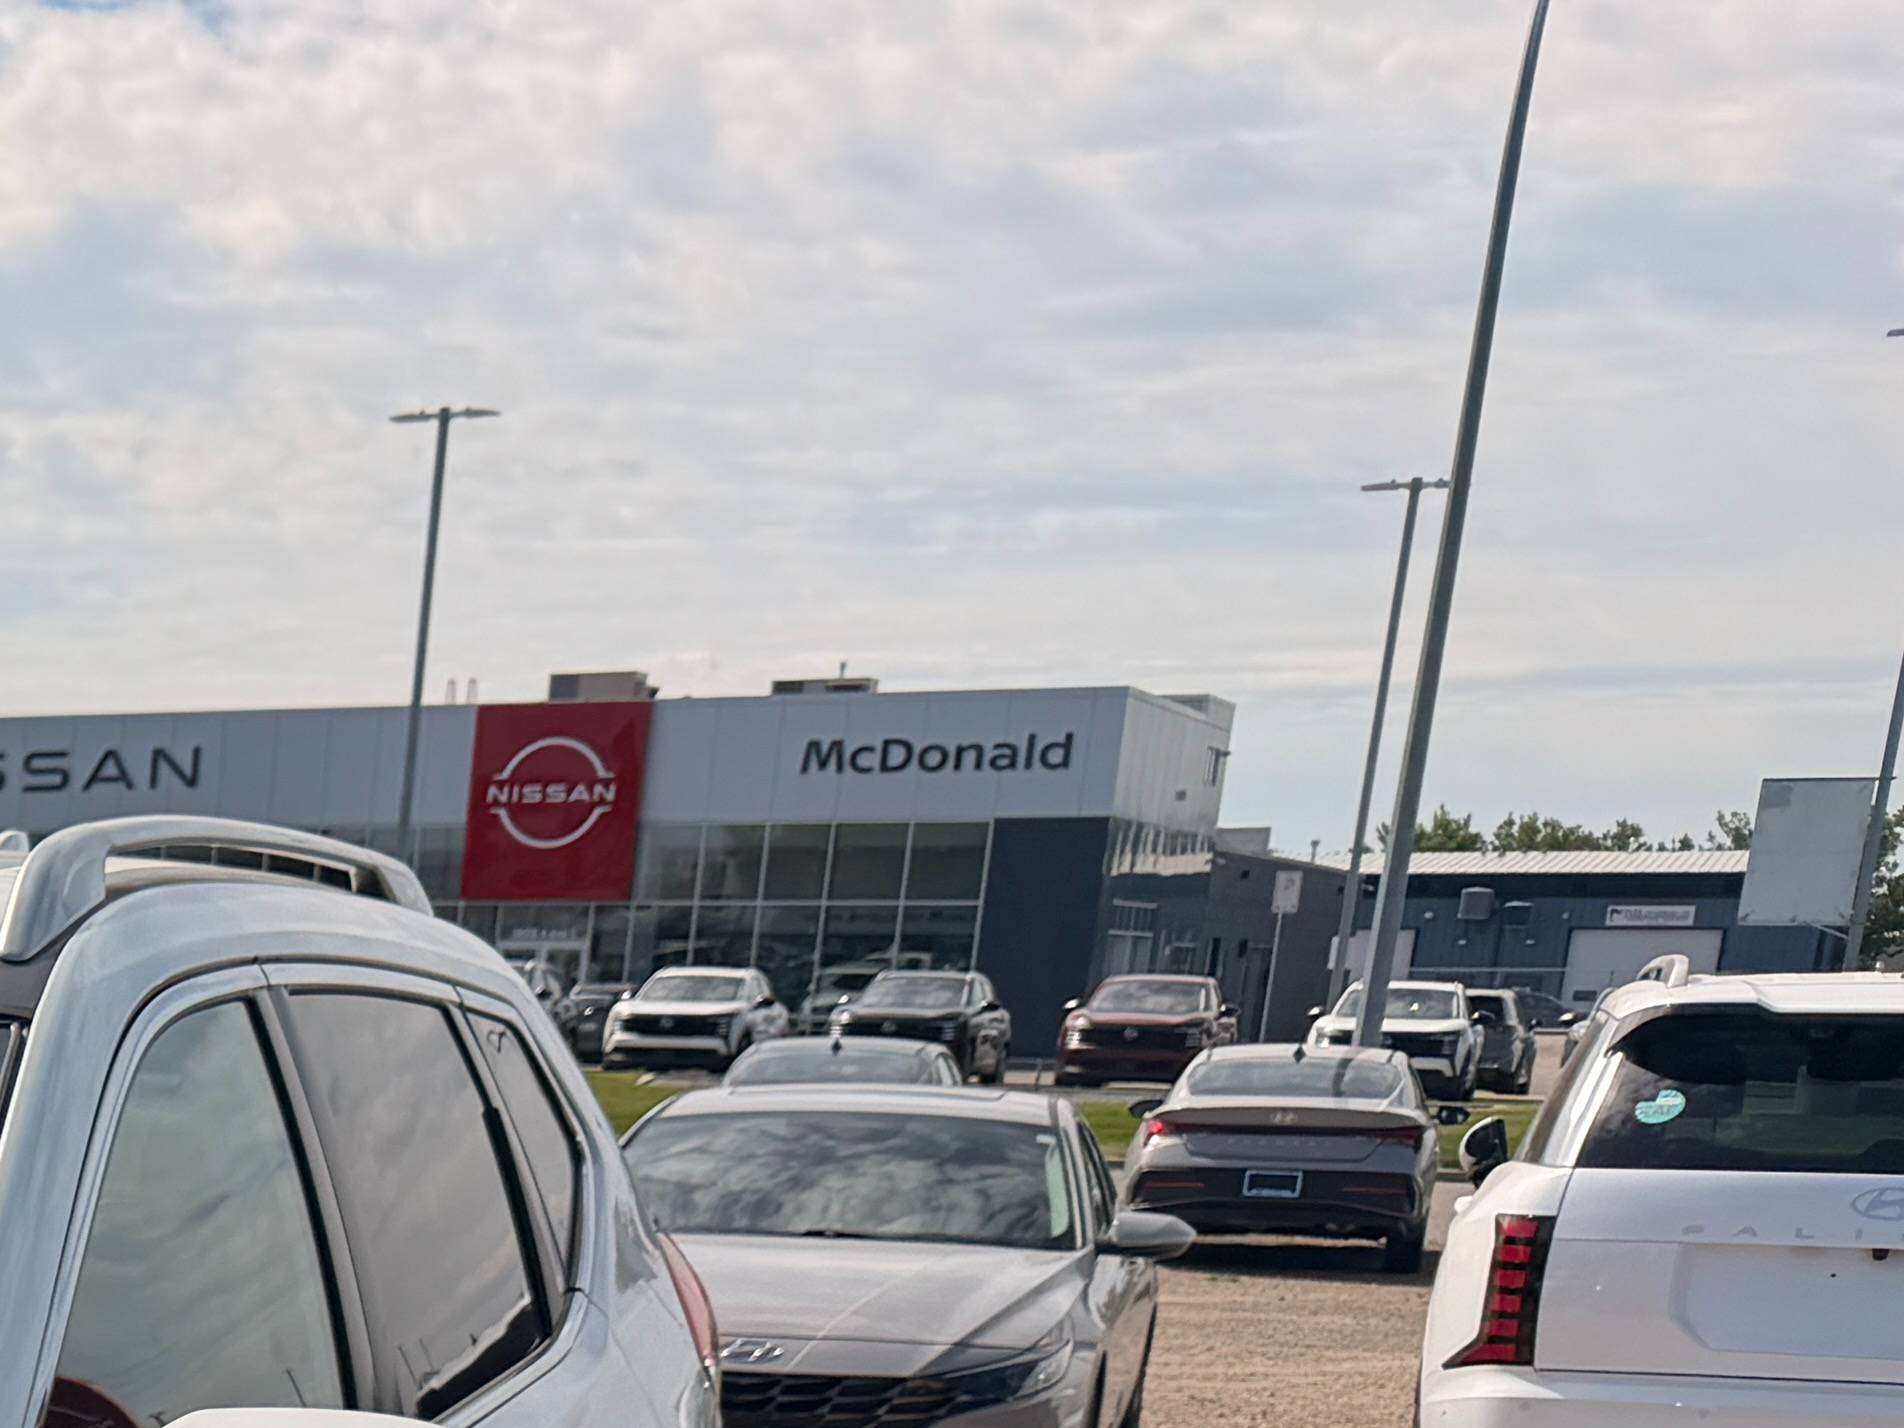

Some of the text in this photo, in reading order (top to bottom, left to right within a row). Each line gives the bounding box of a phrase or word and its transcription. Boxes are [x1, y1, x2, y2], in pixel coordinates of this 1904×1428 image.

[800, 732, 1075, 775] McDonald
[486, 782, 617, 804] NISSAN
[1681, 1224, 1904, 1242] PALI
